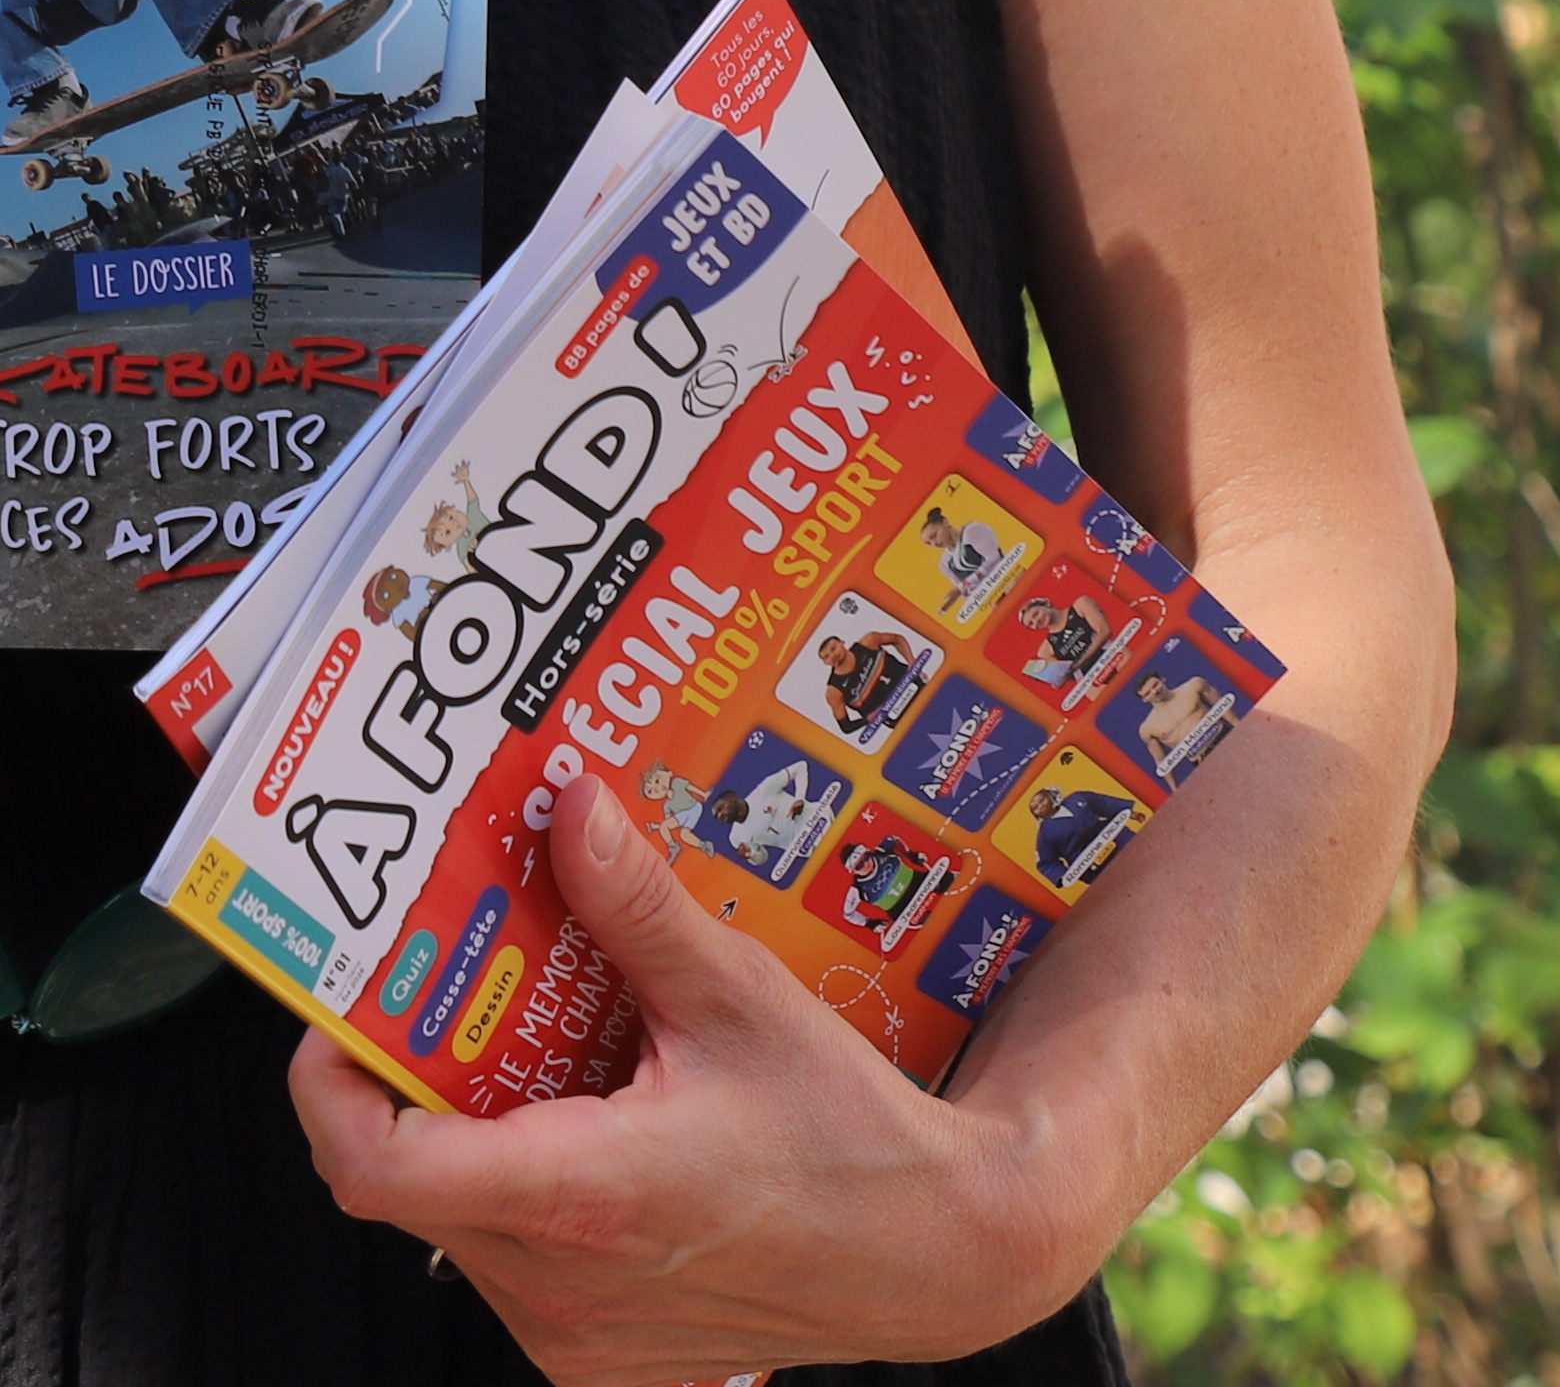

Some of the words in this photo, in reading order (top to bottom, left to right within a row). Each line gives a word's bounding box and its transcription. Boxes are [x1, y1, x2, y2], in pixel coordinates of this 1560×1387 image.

[710, 33, 743, 68] Tous
[743, 11, 763, 33] les
[712, 93, 731, 118] 60
[734, 50, 772, 99] pages
[774, 20, 795, 50] qui
[717, 62, 736, 87] 60
[738, 27, 774, 70] jours,
[729, 58, 785, 123] bougent
[783, 48, 792, 61] !
[662, 161, 742, 252] JEUX
[686, 236, 731, 287] ET
[722, 193, 771, 246] BD
[91, 263, 120, 300] LE
[132, 253, 235, 296] DOSSIER
[564, 344, 587, 370] 88
[586, 290, 630, 346] pages
[629, 265, 650, 289] de
[727, 361, 889, 554] JEUX
[0, 497, 89, 553] CES
[680, 589, 791, 717] 100%
[773, 433, 902, 587] SPORT
[959, 589, 987, 621] Kaylia
[985, 544, 1023, 587] Nemour
[285, 795, 416, 929] À
[363, 386, 662, 794] FOND
[514, 536, 650, 717] Hors-série
[263, 655, 345, 801] NOUVEAU
[339, 641, 354, 656] !
[1184, 697, 1232, 746] Marchand
[918, 782, 942, 801] À
[933, 719, 978, 779] FOND
[186, 852, 219, 898] 7-12
[774, 830, 808, 878] Ousmane
[1065, 842, 1102, 883] Romane
[1102, 813, 1127, 840] Dicko
[206, 870, 229, 905] ans
[232, 889, 286, 939] SPORT
[885, 926, 902, 946] Lou
[901, 862, 946, 923] Jeanmonnot
[282, 927, 322, 967] 100%
[323, 953, 351, 991] N°01
[392, 947, 429, 1001] Quiz
[422, 909, 496, 1037] Casse-tête
[952, 992, 974, 1009] À
[965, 927, 1007, 988] FOND
[466, 970, 513, 1043] Dessin
[583, 1058, 611, 1088] SA
[599, 976, 635, 1050] POCH
[494, 1052, 531, 1091] LE
[525, 1049, 572, 1101] DES
